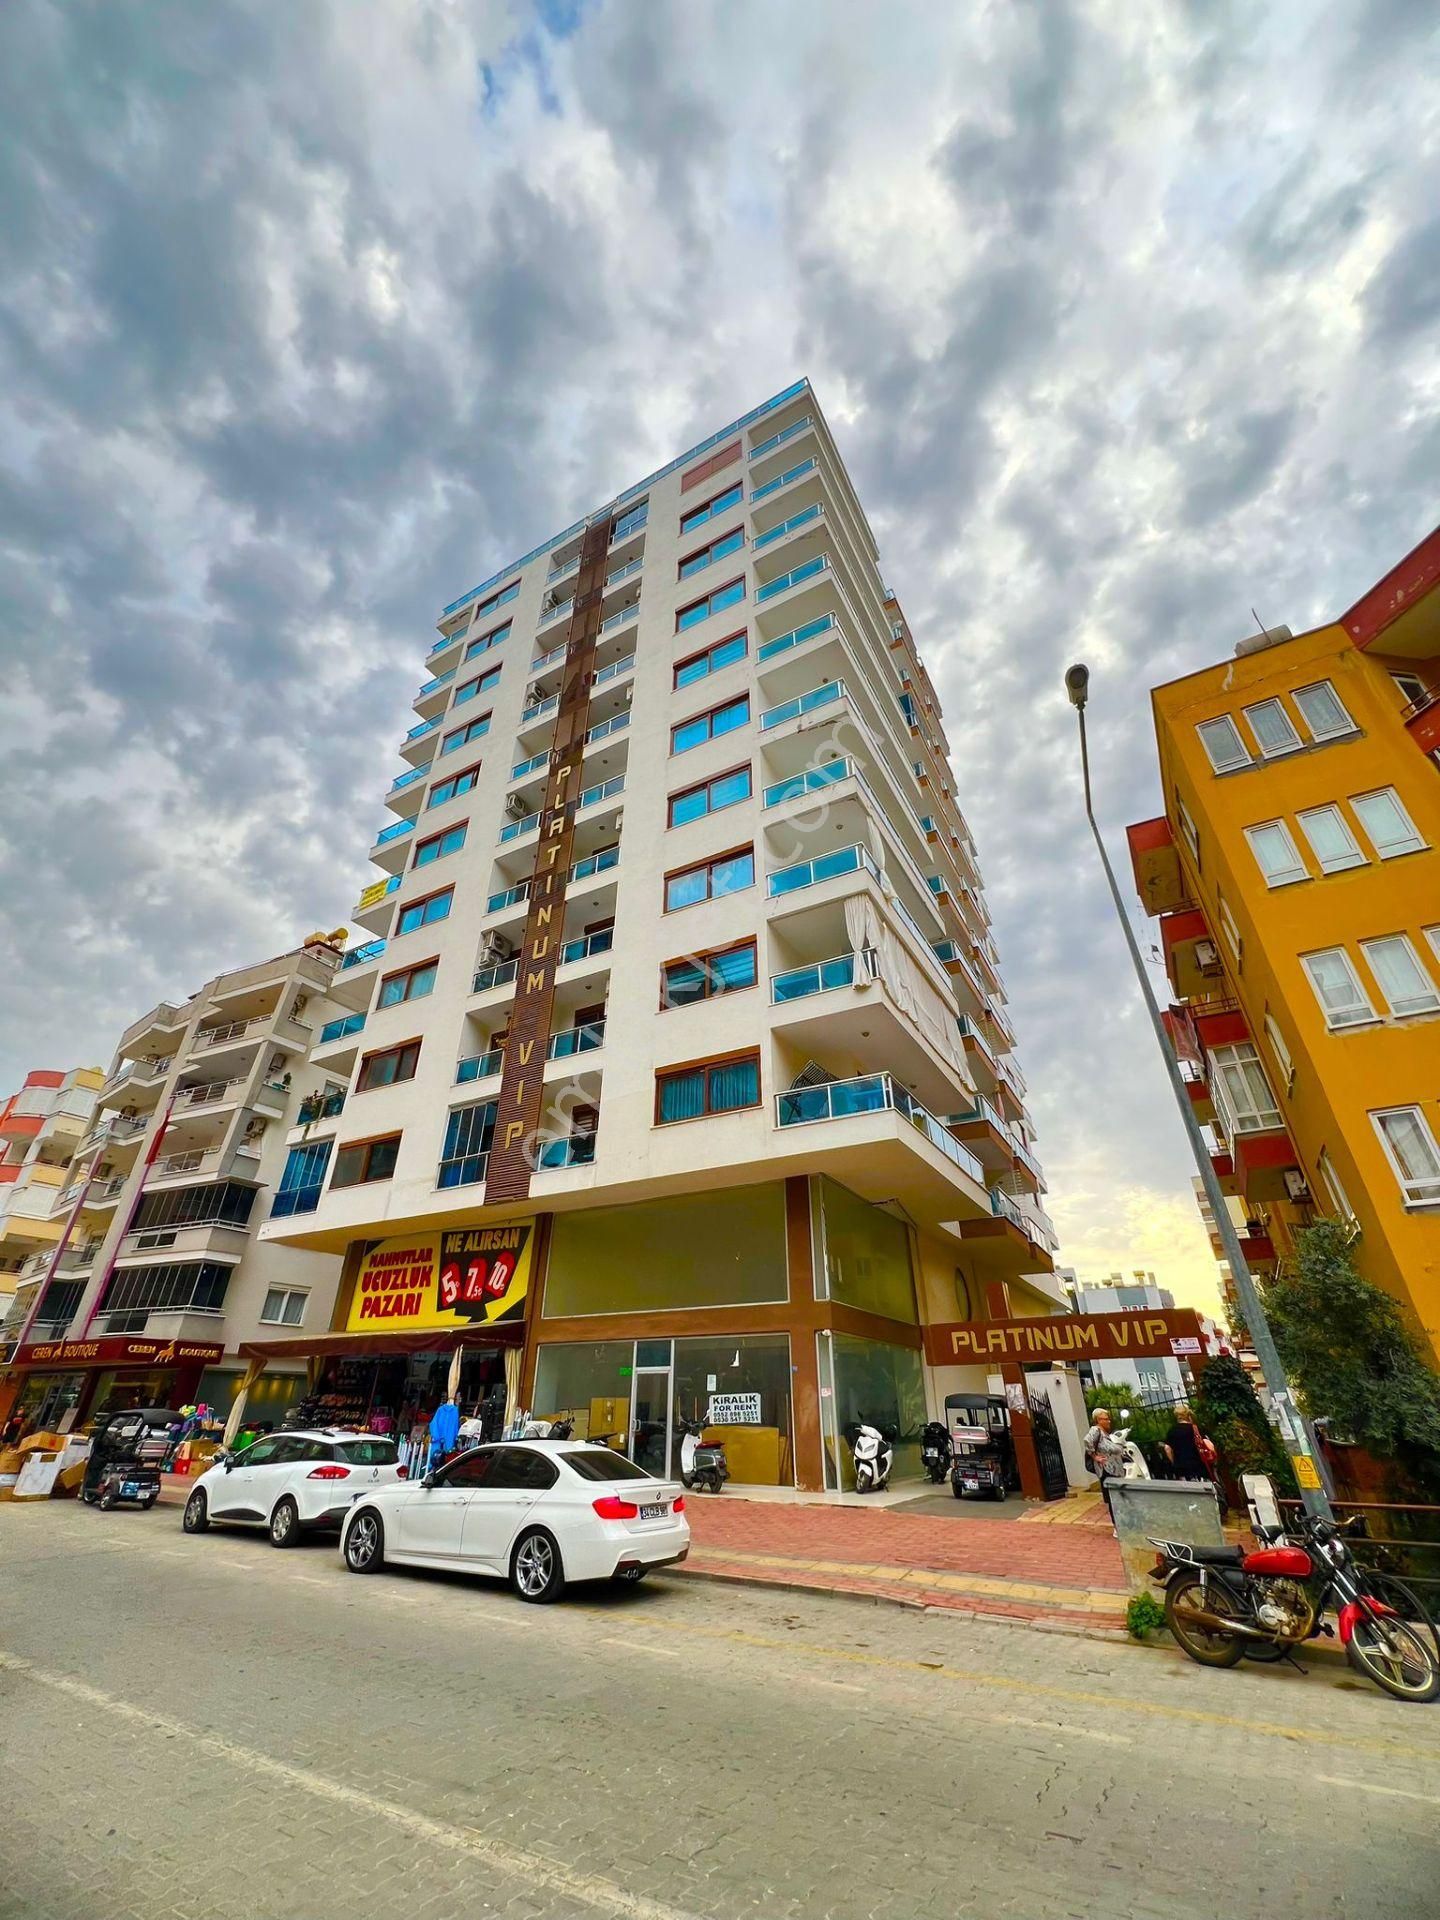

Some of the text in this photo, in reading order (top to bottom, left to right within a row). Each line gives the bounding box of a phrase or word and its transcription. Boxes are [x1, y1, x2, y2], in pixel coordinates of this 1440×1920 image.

[505, 765, 571, 1150] PLATINUM VIP
[445, 1228, 520, 1253] NE ALIRSAN
[361, 1265, 434, 1293] UCUZLUK
[359, 1292, 423, 1319] PAZARI
[63, 1343, 100, 1358] BOUTIQUE
[951, 1323, 1099, 1355] PLATINUM
[1108, 1319, 1168, 1347] VIP
[179, 1348, 220, 1357] BOUTIQUE
